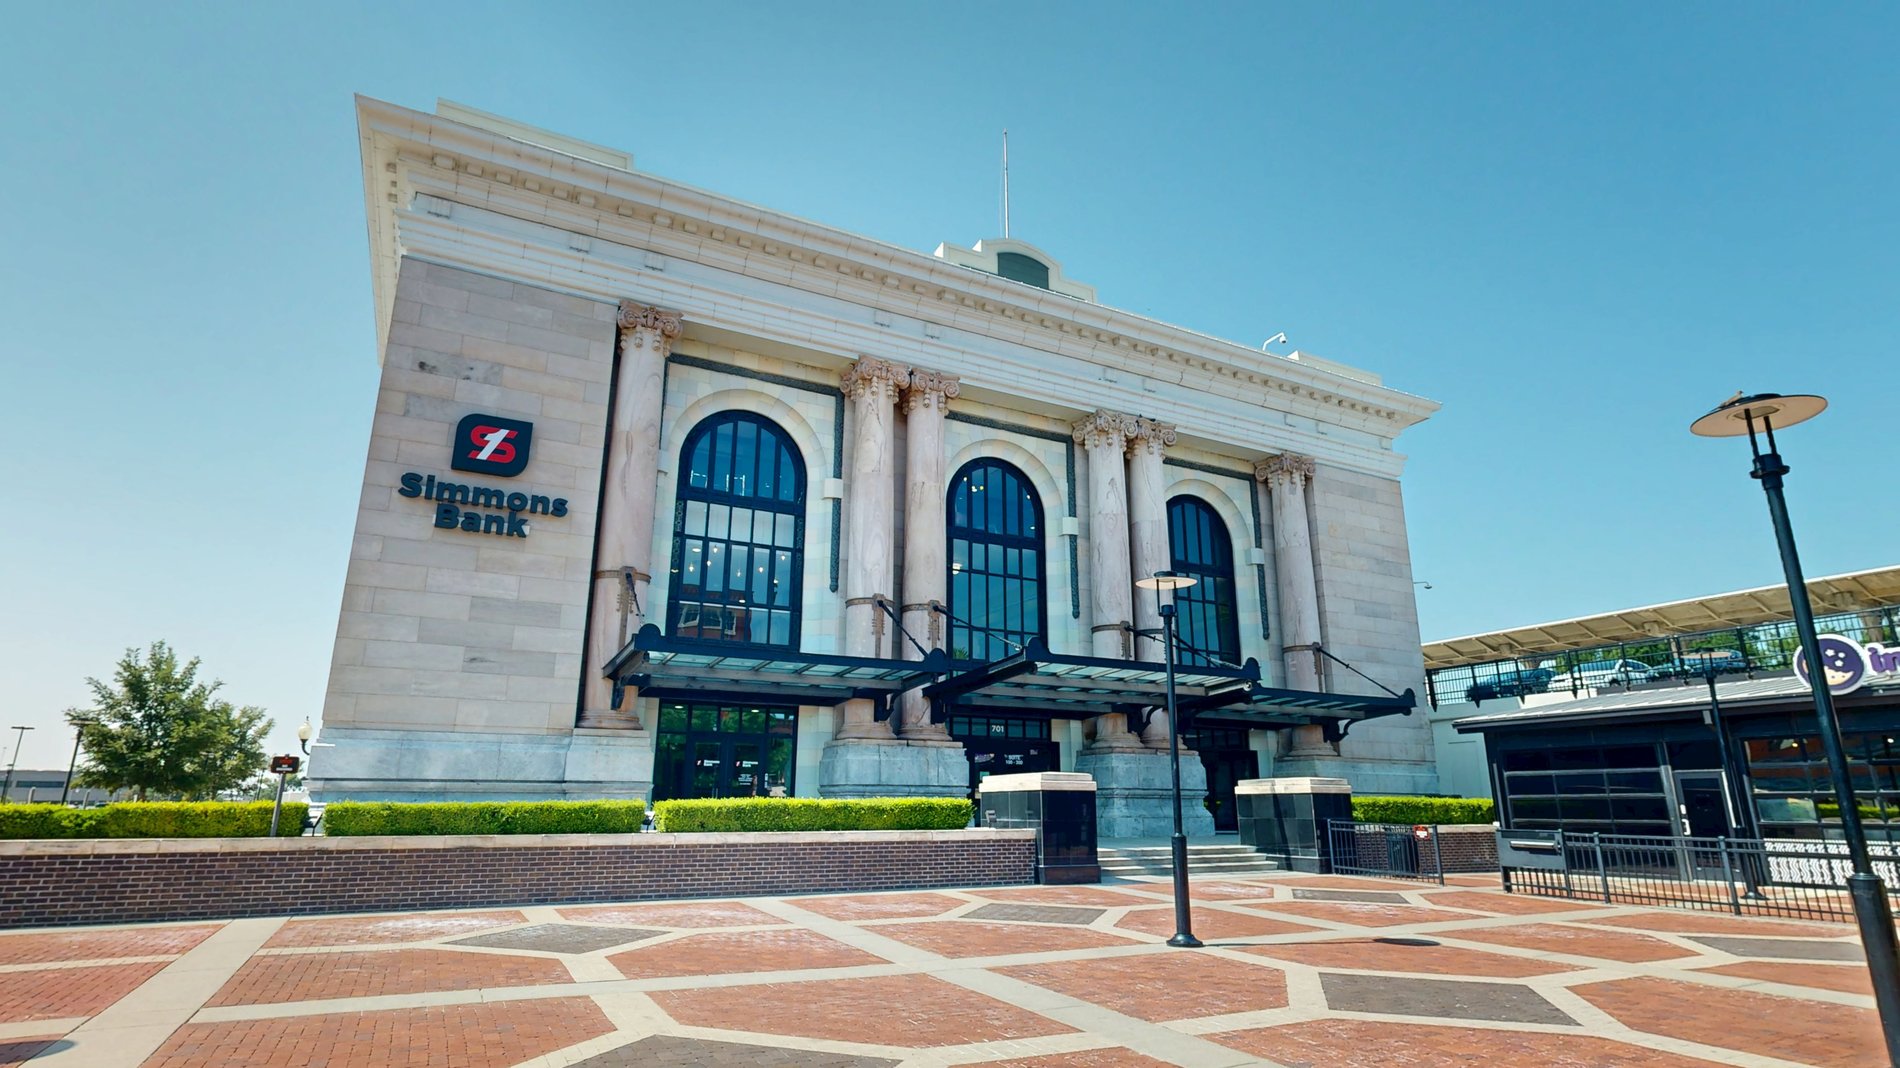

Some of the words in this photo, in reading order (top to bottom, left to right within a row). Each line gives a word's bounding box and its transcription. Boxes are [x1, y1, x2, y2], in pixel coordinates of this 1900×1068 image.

[398, 472, 569, 517] Simmons
[434, 502, 528, 538] Bank
[991, 725, 1004, 733] 701
